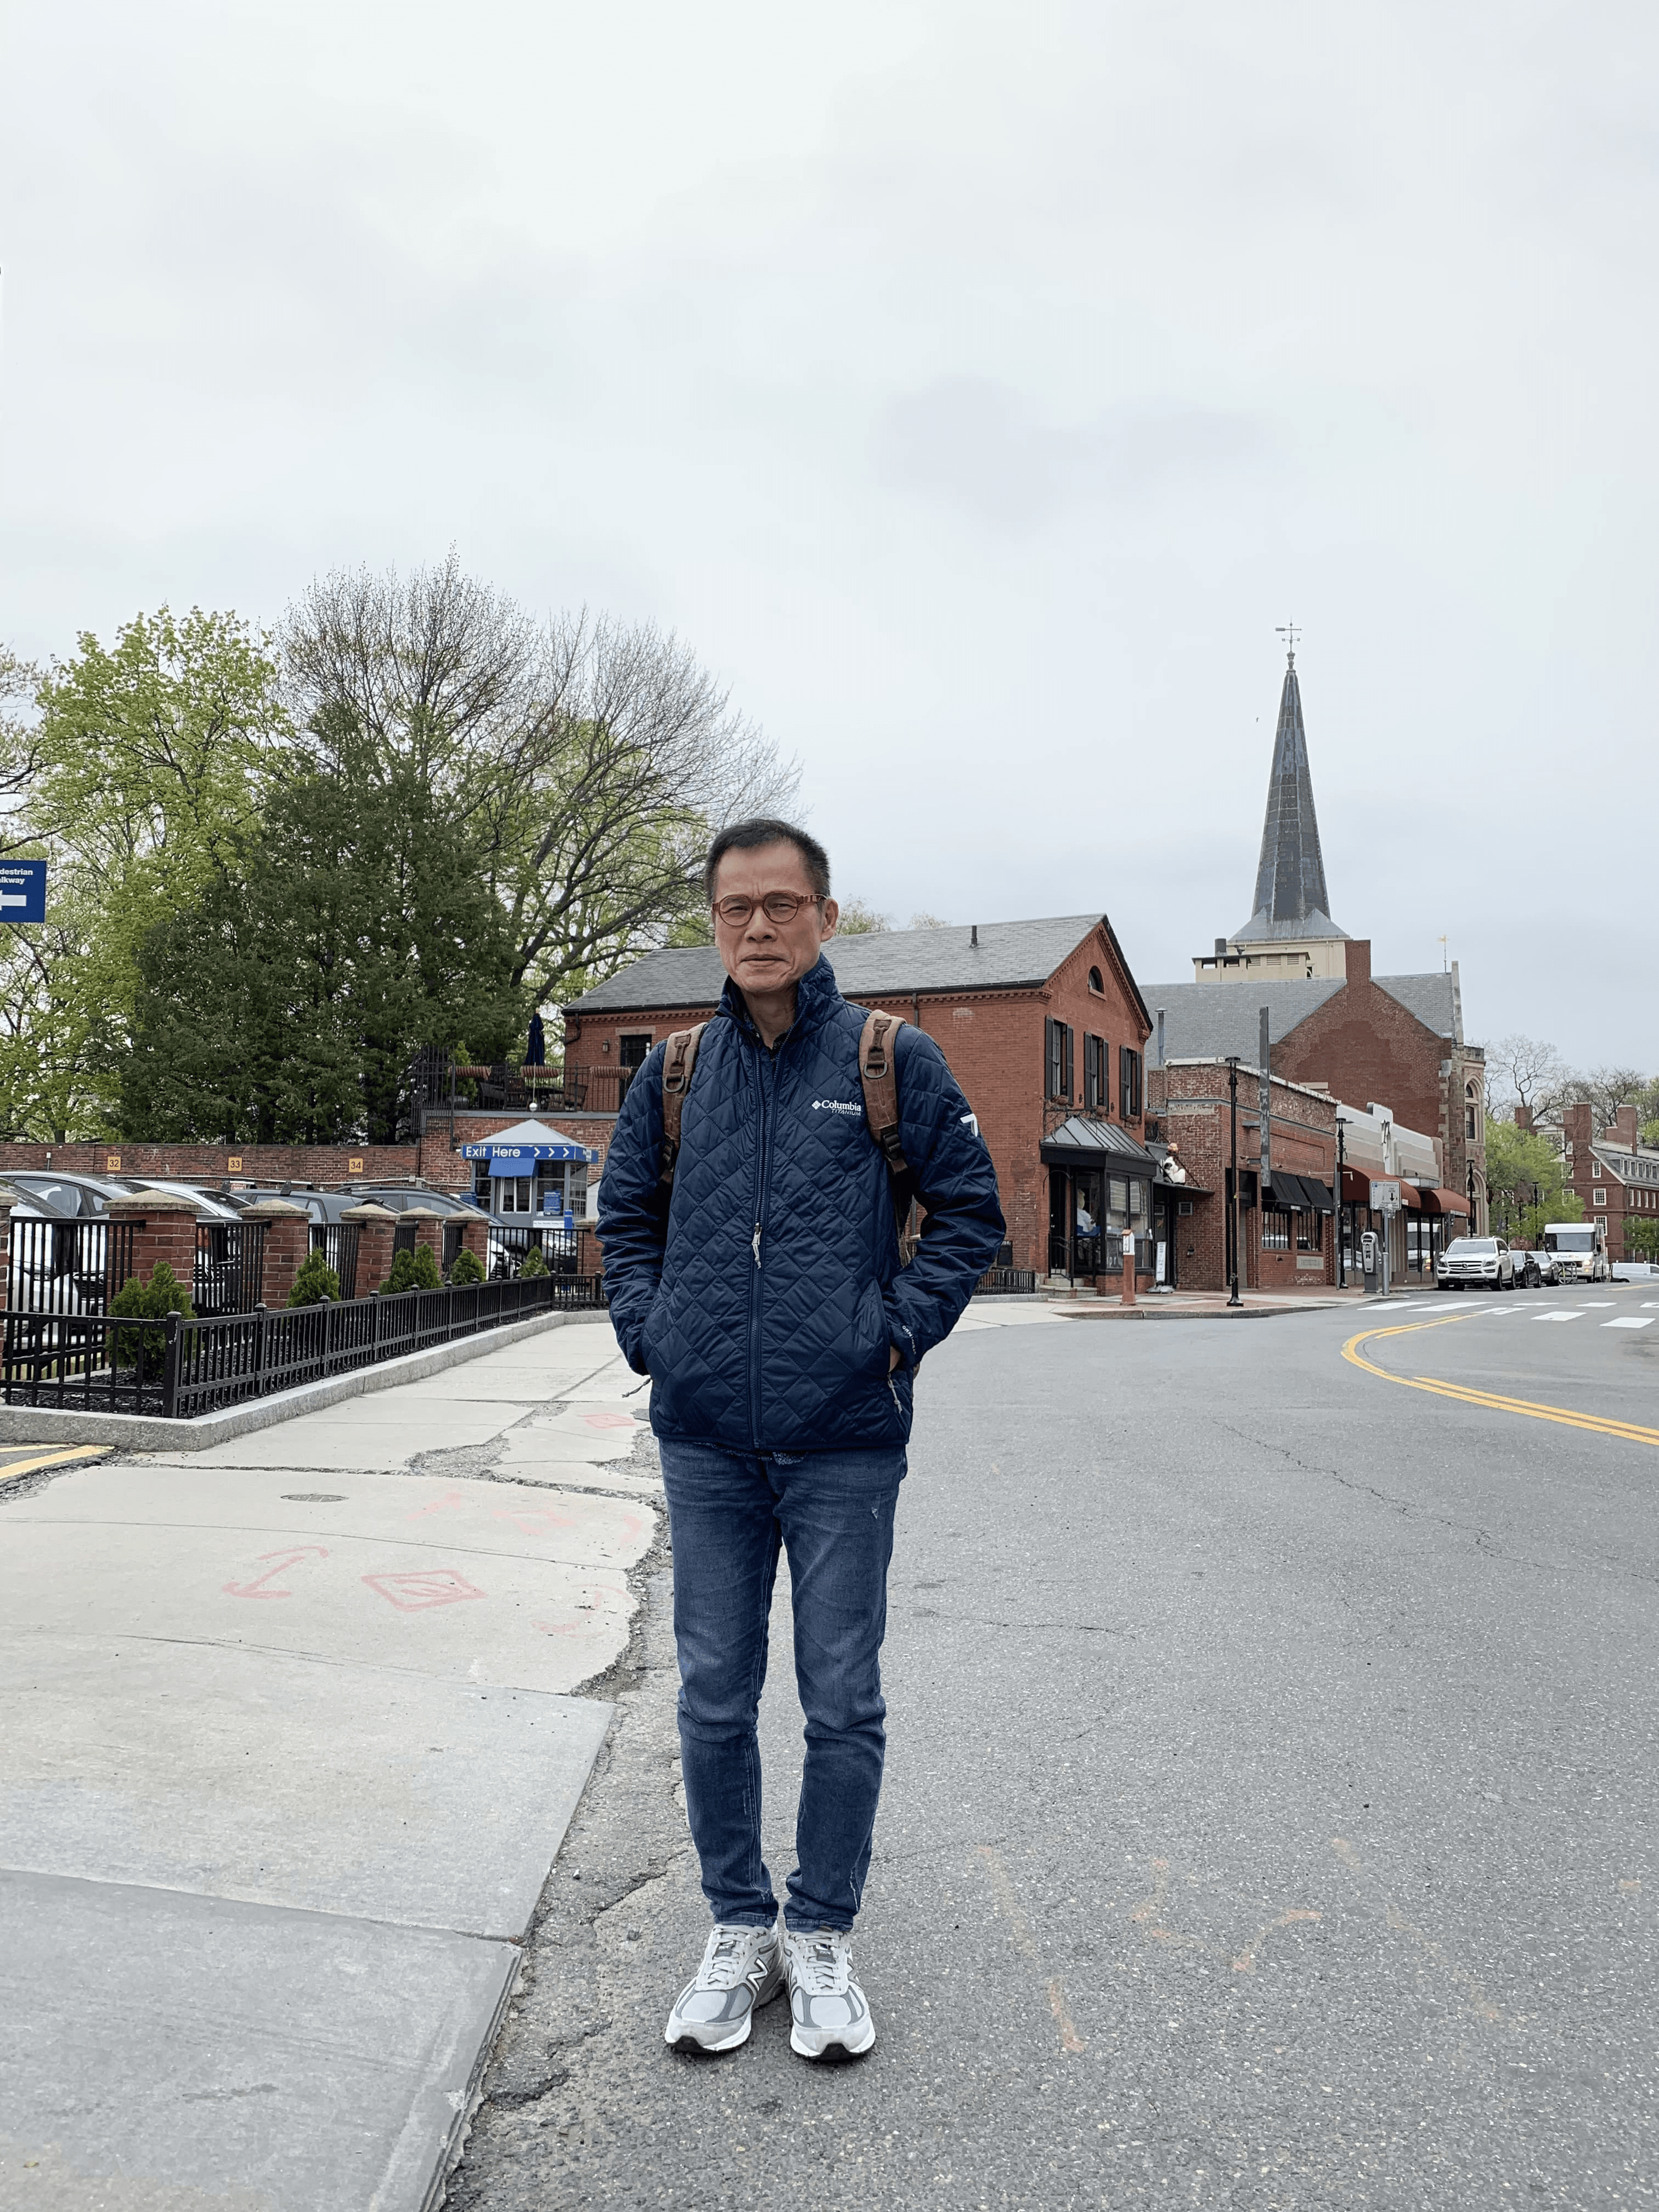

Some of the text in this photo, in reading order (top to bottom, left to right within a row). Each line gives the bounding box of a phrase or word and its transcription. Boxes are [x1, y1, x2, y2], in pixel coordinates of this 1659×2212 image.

[0, 877, 25, 885] lkway
[821, 1100, 861, 1111] Columbia
[831, 1108, 861, 1116] TITANIUM
[466, 1146, 521, 1158] Exit Here
[110, 1159, 119, 1167] 32
[351, 1161, 361, 1170] 34
